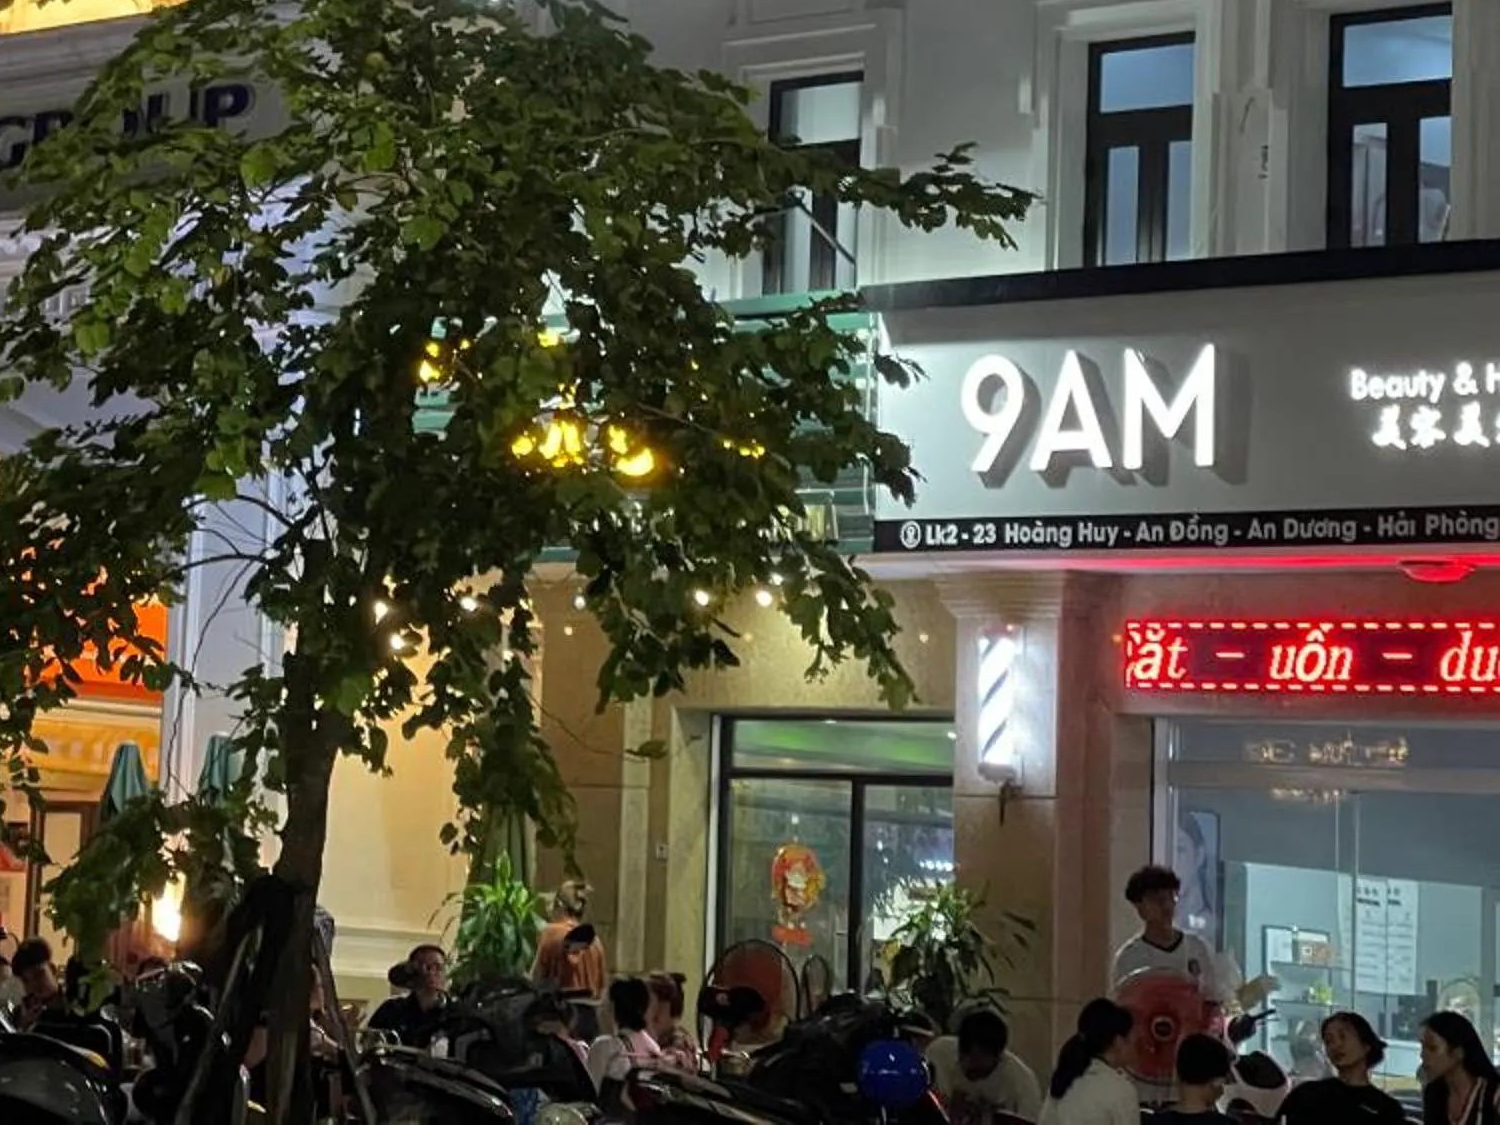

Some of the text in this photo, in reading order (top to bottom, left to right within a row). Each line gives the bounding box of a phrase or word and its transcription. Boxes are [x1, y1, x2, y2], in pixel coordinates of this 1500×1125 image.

[1350, 368, 1446, 404] Beauty
[1453, 361, 1479, 396] &
[960, 343, 1216, 473] 9AM
[925, 523, 958, 546] Lk2
[973, 522, 997, 544] 23
[1004, 520, 1073, 548] Hoàng
[1078, 520, 1118, 547] Huy
[1136, 521, 1165, 543] An
[1247, 518, 1277, 540] An
[1284, 518, 1357, 542] Dương
[1425, 509, 1500, 541] Phòng
[1440, 630, 1500, 682] du
